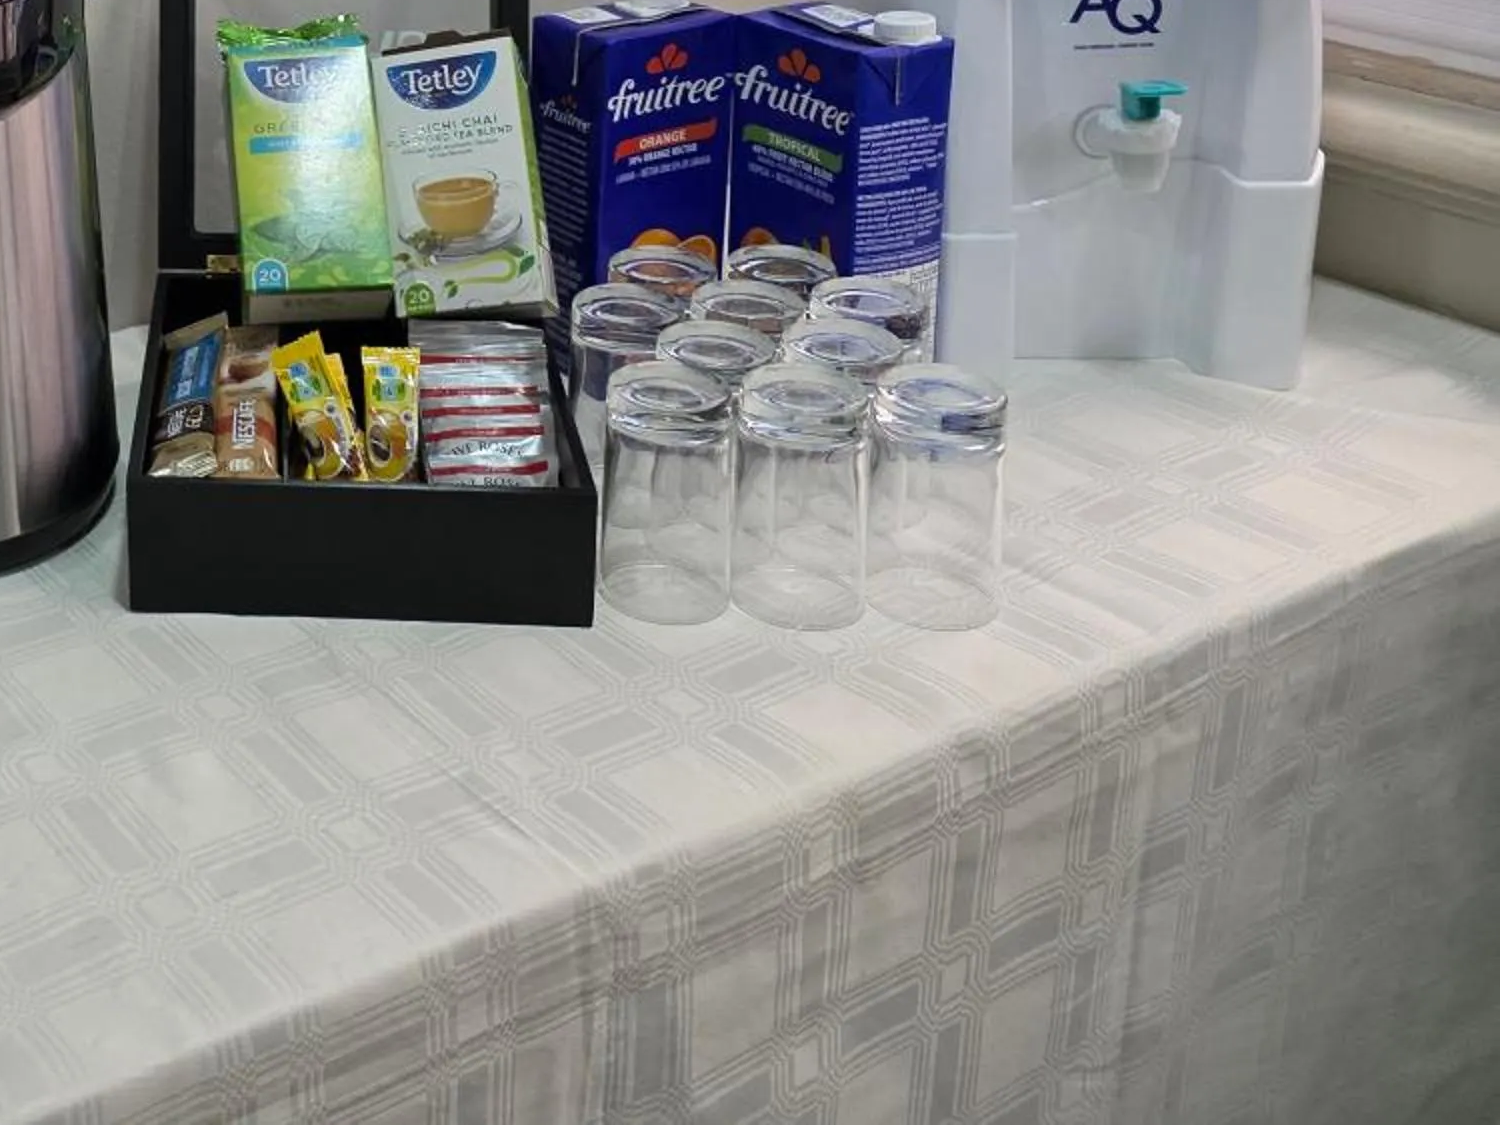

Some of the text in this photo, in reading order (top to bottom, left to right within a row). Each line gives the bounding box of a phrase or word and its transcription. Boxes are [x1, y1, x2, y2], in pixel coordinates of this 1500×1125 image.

[401, 59, 484, 95] Tetley
[607, 75, 725, 123] fruitree
[734, 64, 851, 136] fruitree
[639, 129, 687, 150] ORANGE
[768, 131, 821, 161] TROPICAL
[259, 268, 282, 283] 20
[408, 290, 430, 305] 20
